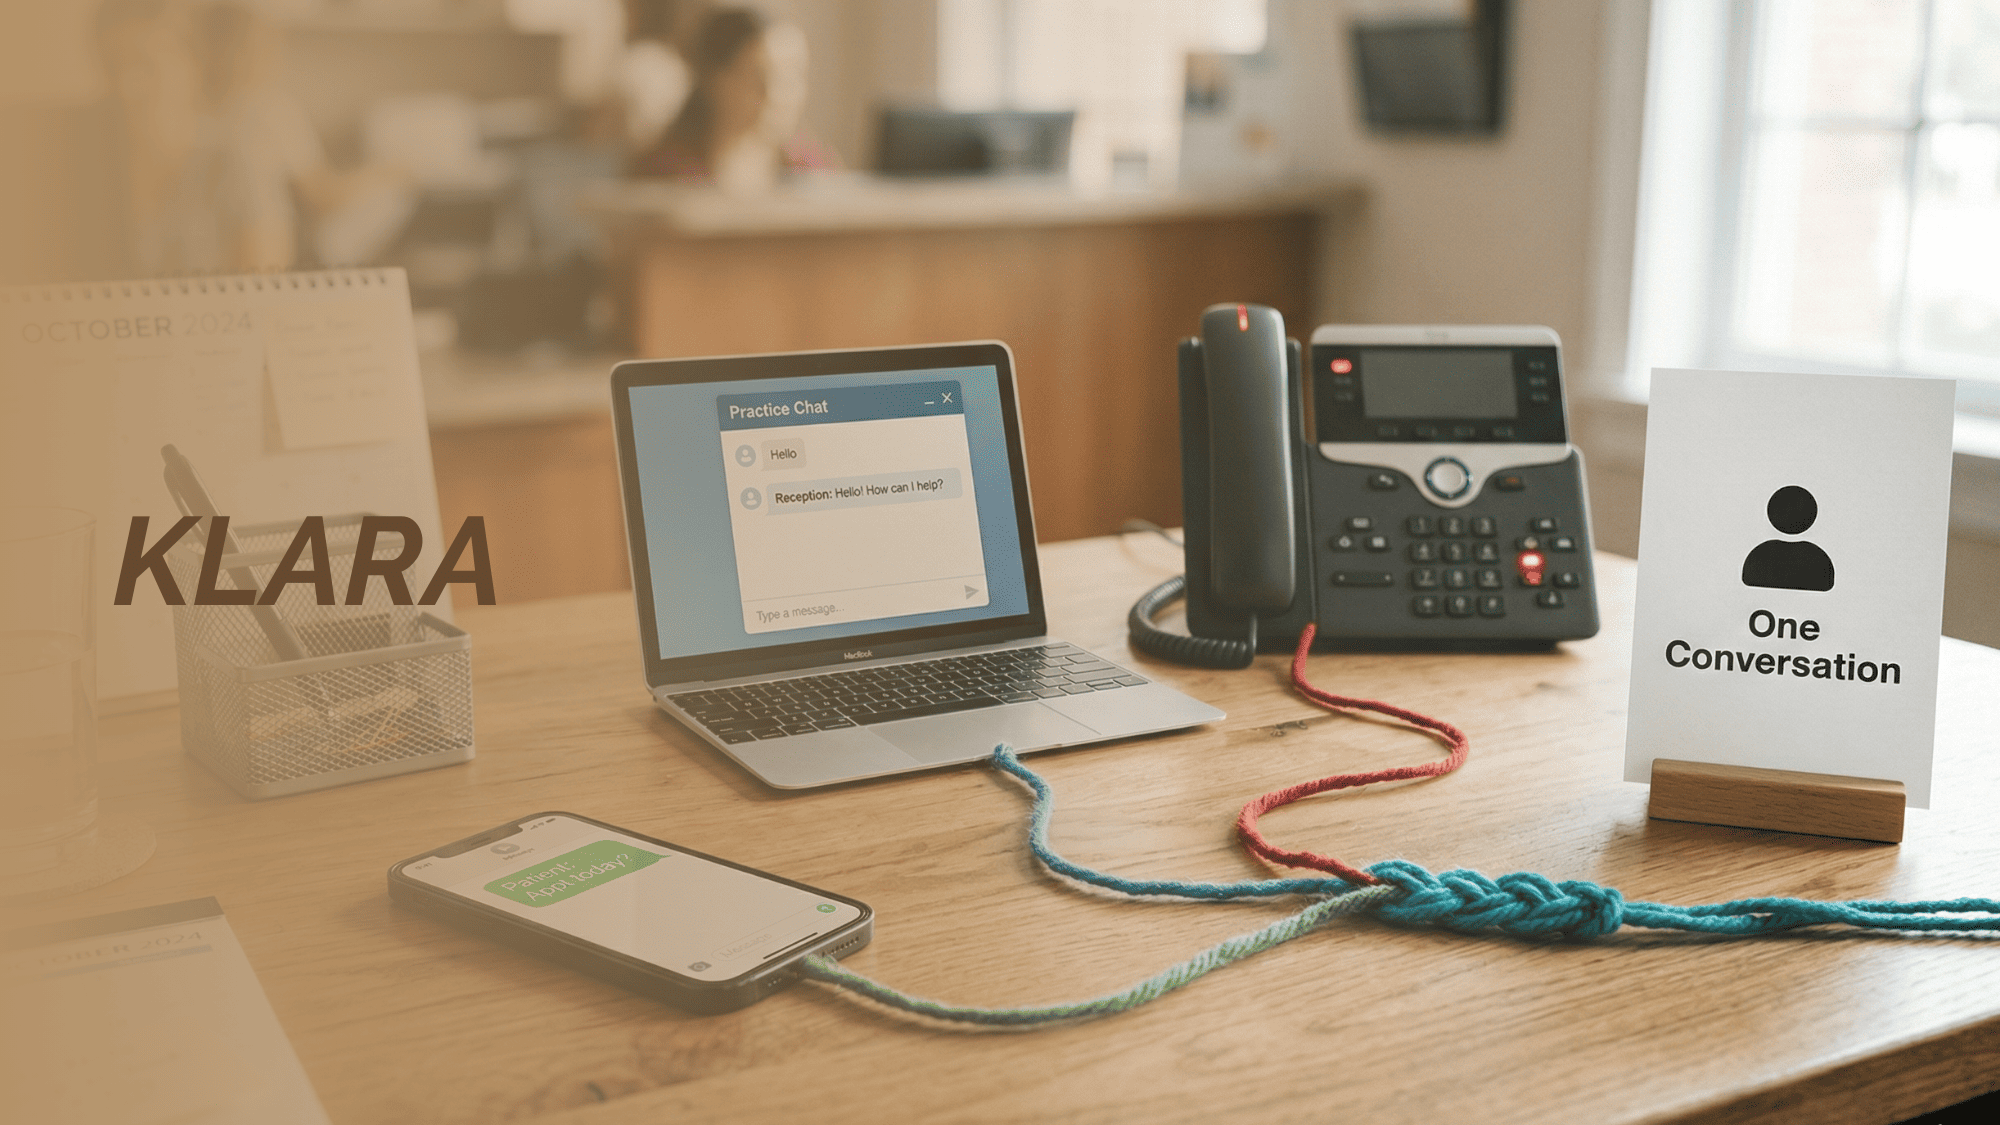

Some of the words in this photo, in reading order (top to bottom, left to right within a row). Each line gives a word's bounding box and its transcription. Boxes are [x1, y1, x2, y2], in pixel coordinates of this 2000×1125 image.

[21, 315, 172, 343] OCTOBER
[182, 310, 252, 337] 2024
[729, 402, 790, 419] Practice
[794, 399, 829, 414] Chat
[770, 448, 797, 460] Hello
[775, 489, 832, 504] Reception:
[835, 485, 864, 498] Hello!
[866, 484, 888, 496] How
[890, 482, 909, 493] can
[917, 478, 943, 492] help?
[756, 610, 780, 624] Type
[783, 609, 790, 618] a
[792, 604, 844, 616] message...
[1748, 609, 1820, 641] One
[1665, 640, 1901, 684] Conversation
[501, 861, 576, 891] Patient:
[526, 879, 576, 901] Appt
